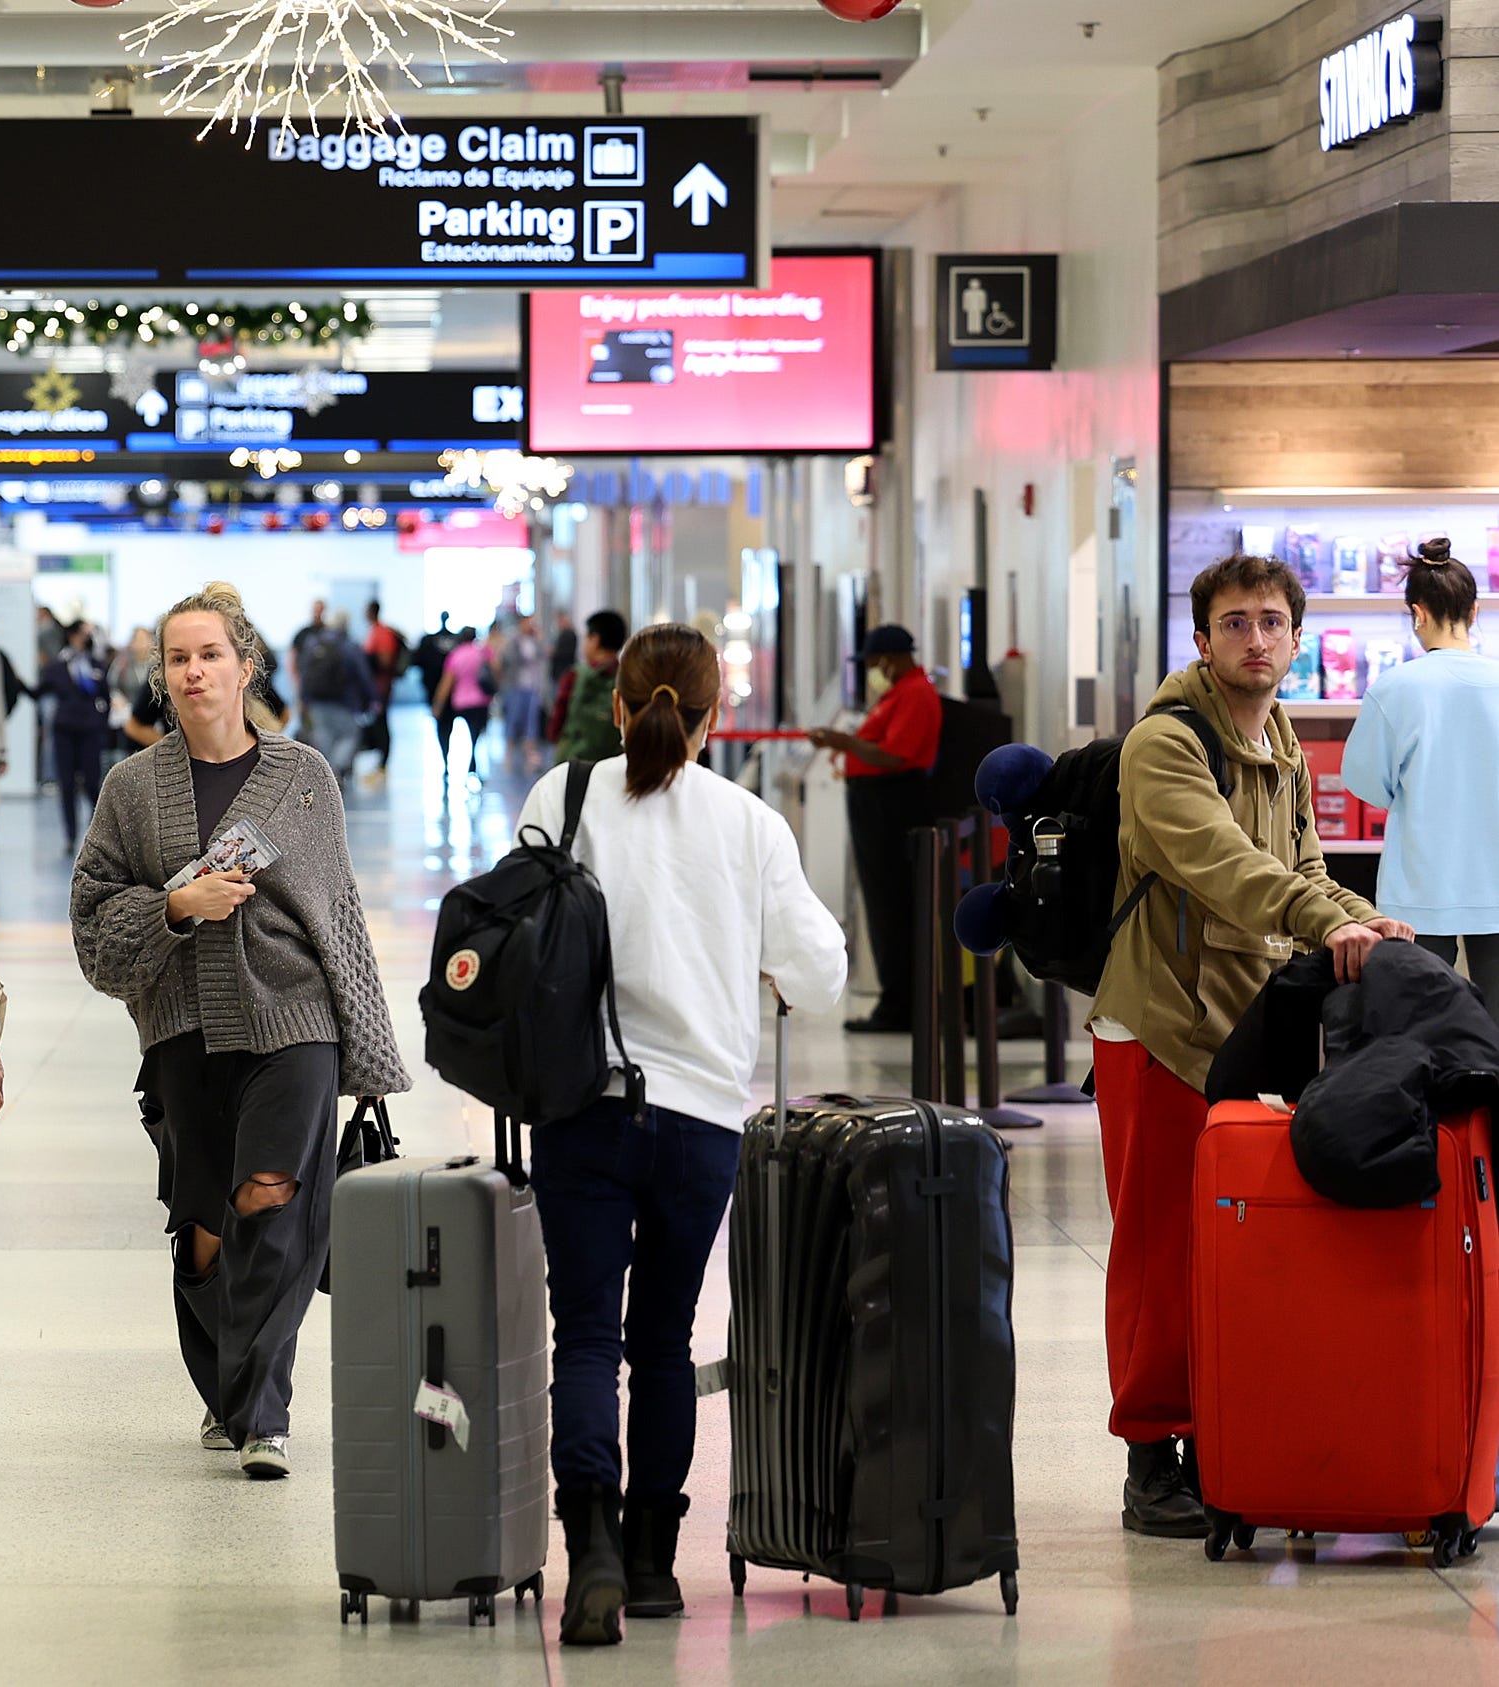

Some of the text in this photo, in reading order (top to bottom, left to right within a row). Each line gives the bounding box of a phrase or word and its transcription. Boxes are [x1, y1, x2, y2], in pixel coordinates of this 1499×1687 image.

[1320, 14, 1414, 151] STARBUCKS
[269, 126, 574, 169] Baggage Claim
[379, 167, 574, 190] Reclamo de Equipaje
[419, 201, 575, 244] Parking
[422, 241, 574, 262] Estacionamiento
[731, 293, 822, 321] boarding
[473, 385, 523, 422] EX
